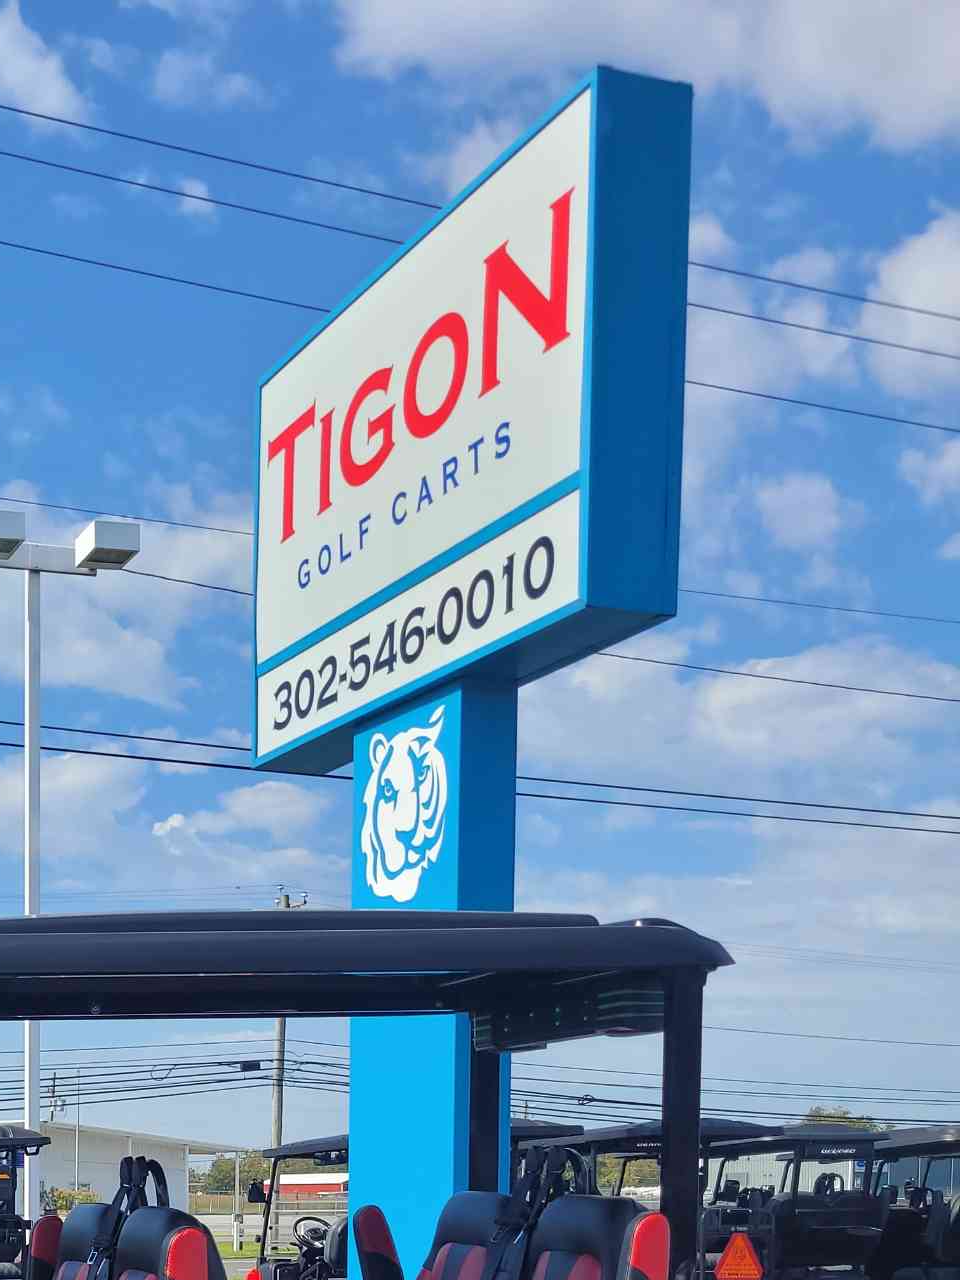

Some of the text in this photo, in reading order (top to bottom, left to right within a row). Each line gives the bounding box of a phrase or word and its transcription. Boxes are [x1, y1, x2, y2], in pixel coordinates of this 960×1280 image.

[267, 186, 576, 543] TIGON
[297, 420, 512, 589] GOLF CARTS
[272, 535, 556, 731] 302-546-0010
